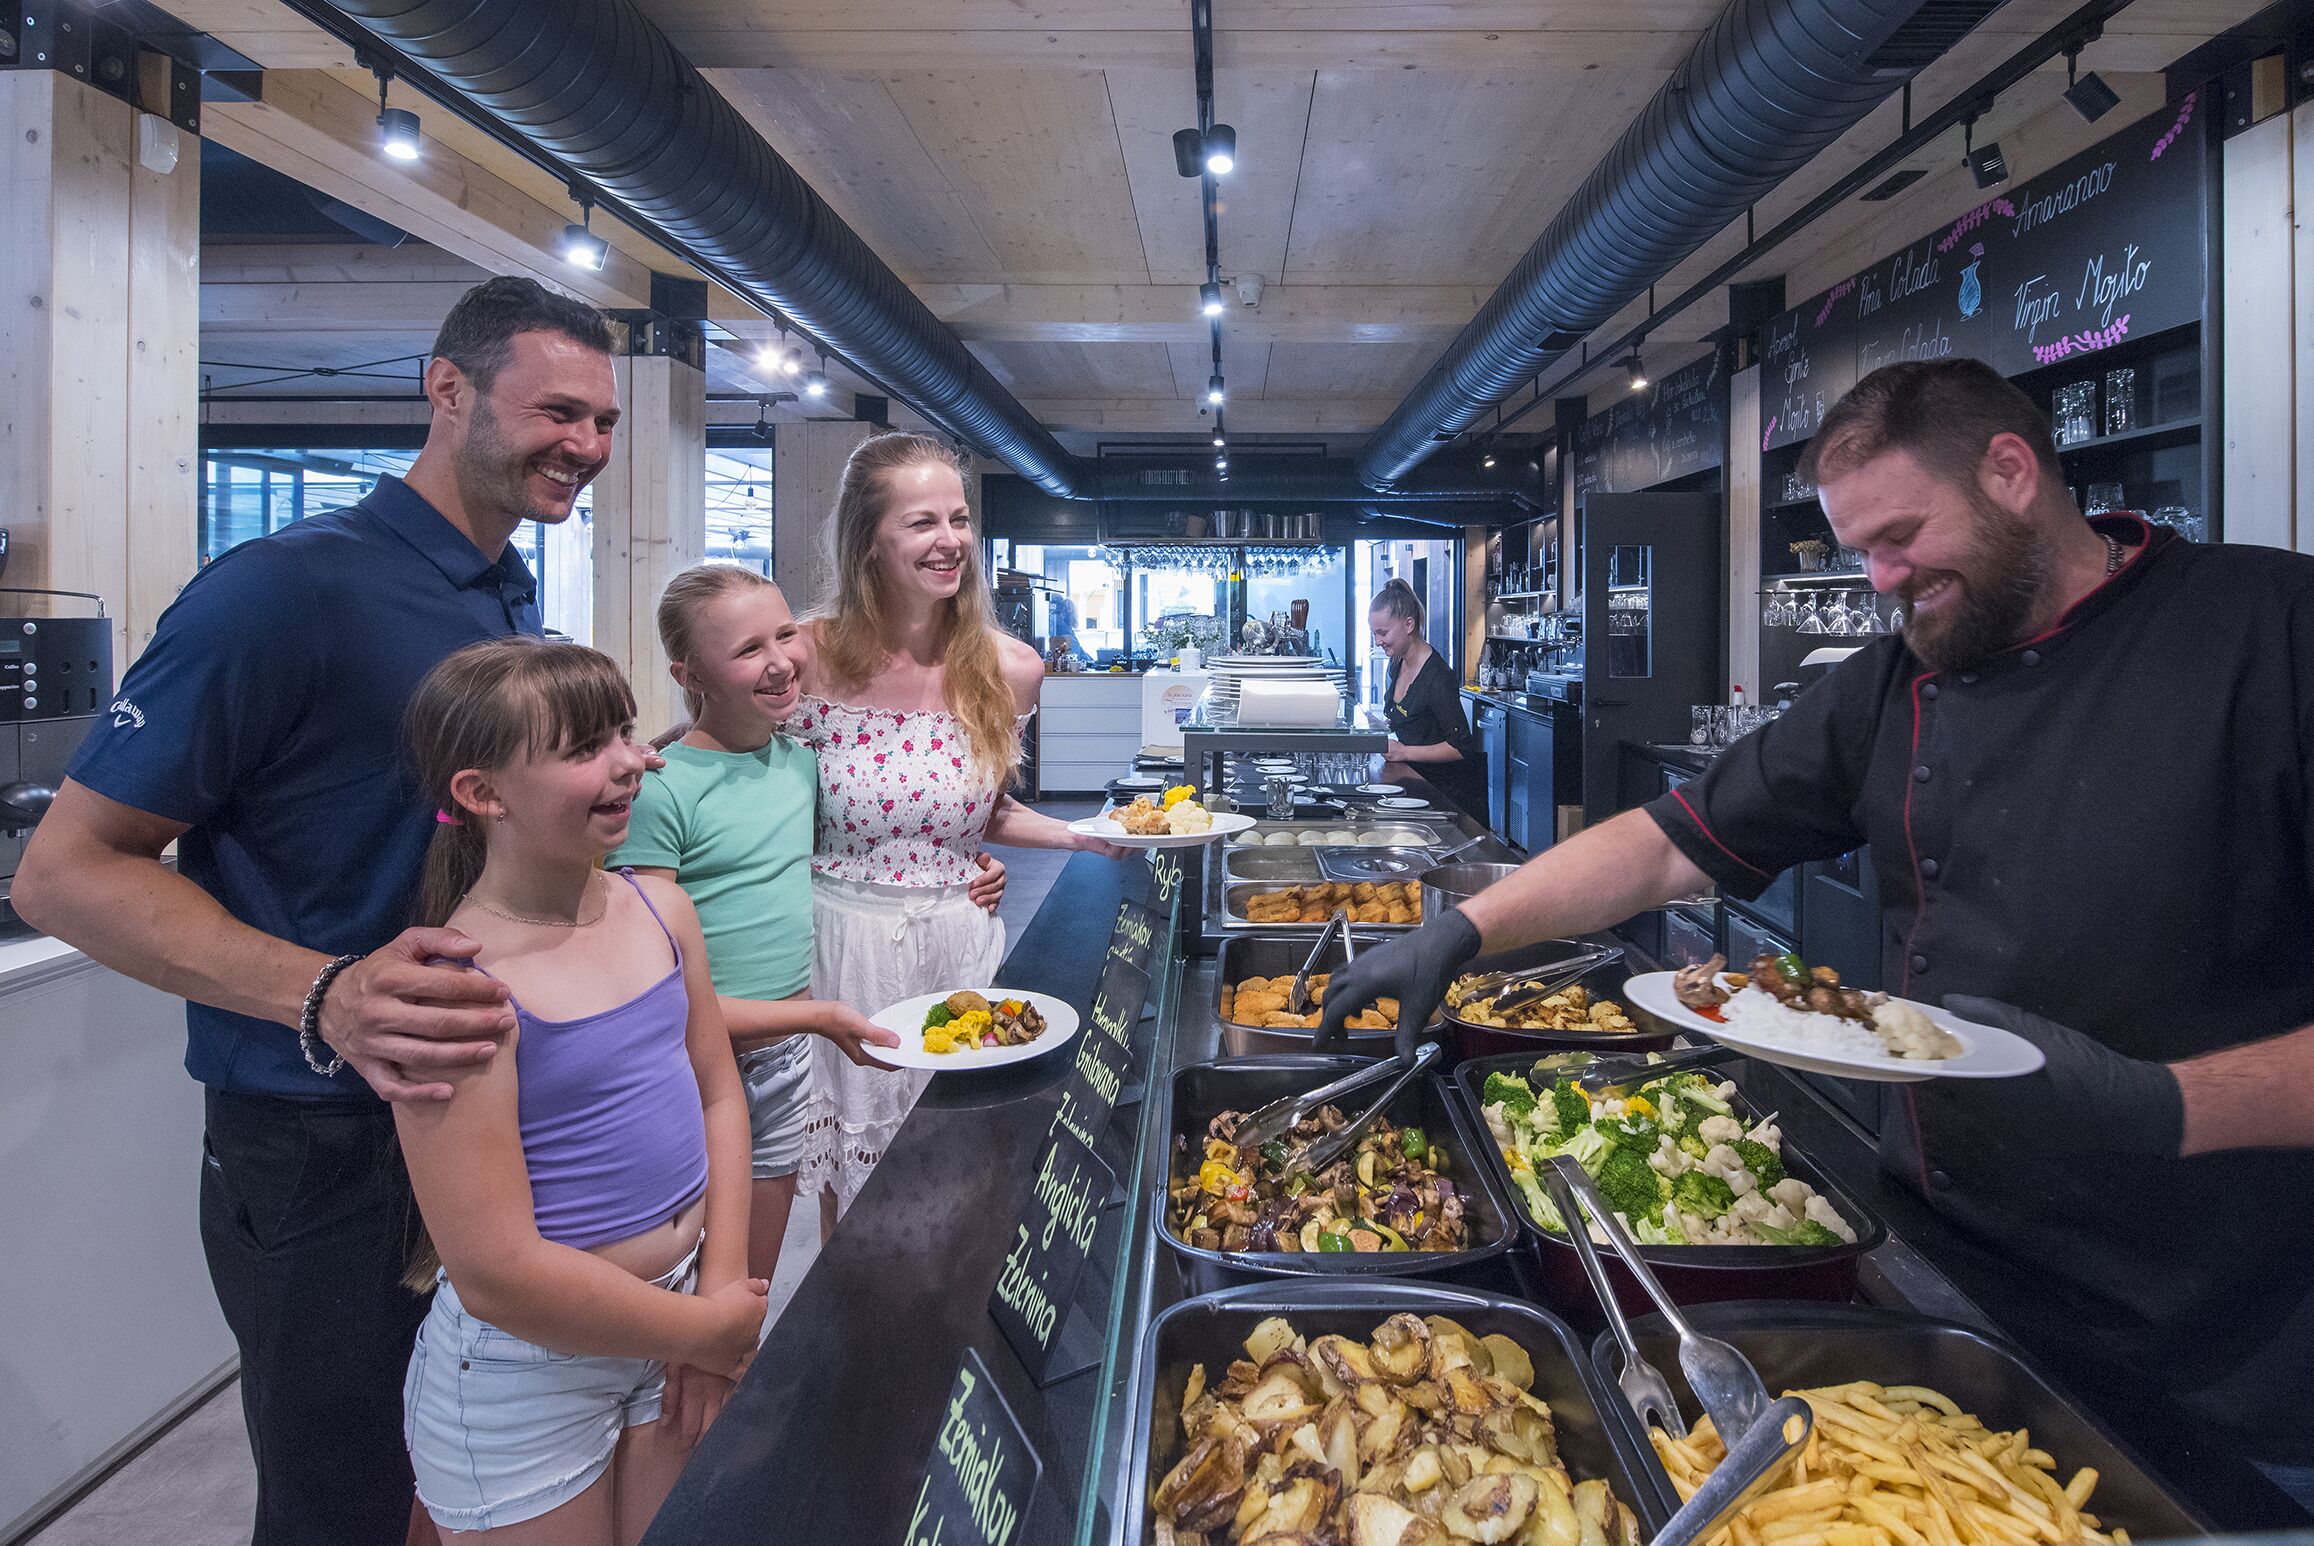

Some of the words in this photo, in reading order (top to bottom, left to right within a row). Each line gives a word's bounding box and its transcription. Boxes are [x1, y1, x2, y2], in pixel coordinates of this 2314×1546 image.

[2013, 162, 2117, 237] Amarancio
[1890, 238, 1940, 301] Colada
[2015, 275, 2060, 343] Virgin
[2076, 244, 2151, 328] Mojito
[1780, 393, 1810, 440] Mojito
[110, 698, 146, 728] Callaway
[1034, 1142, 1105, 1257] Anglická
[996, 1223, 1057, 1351] Zelenina
